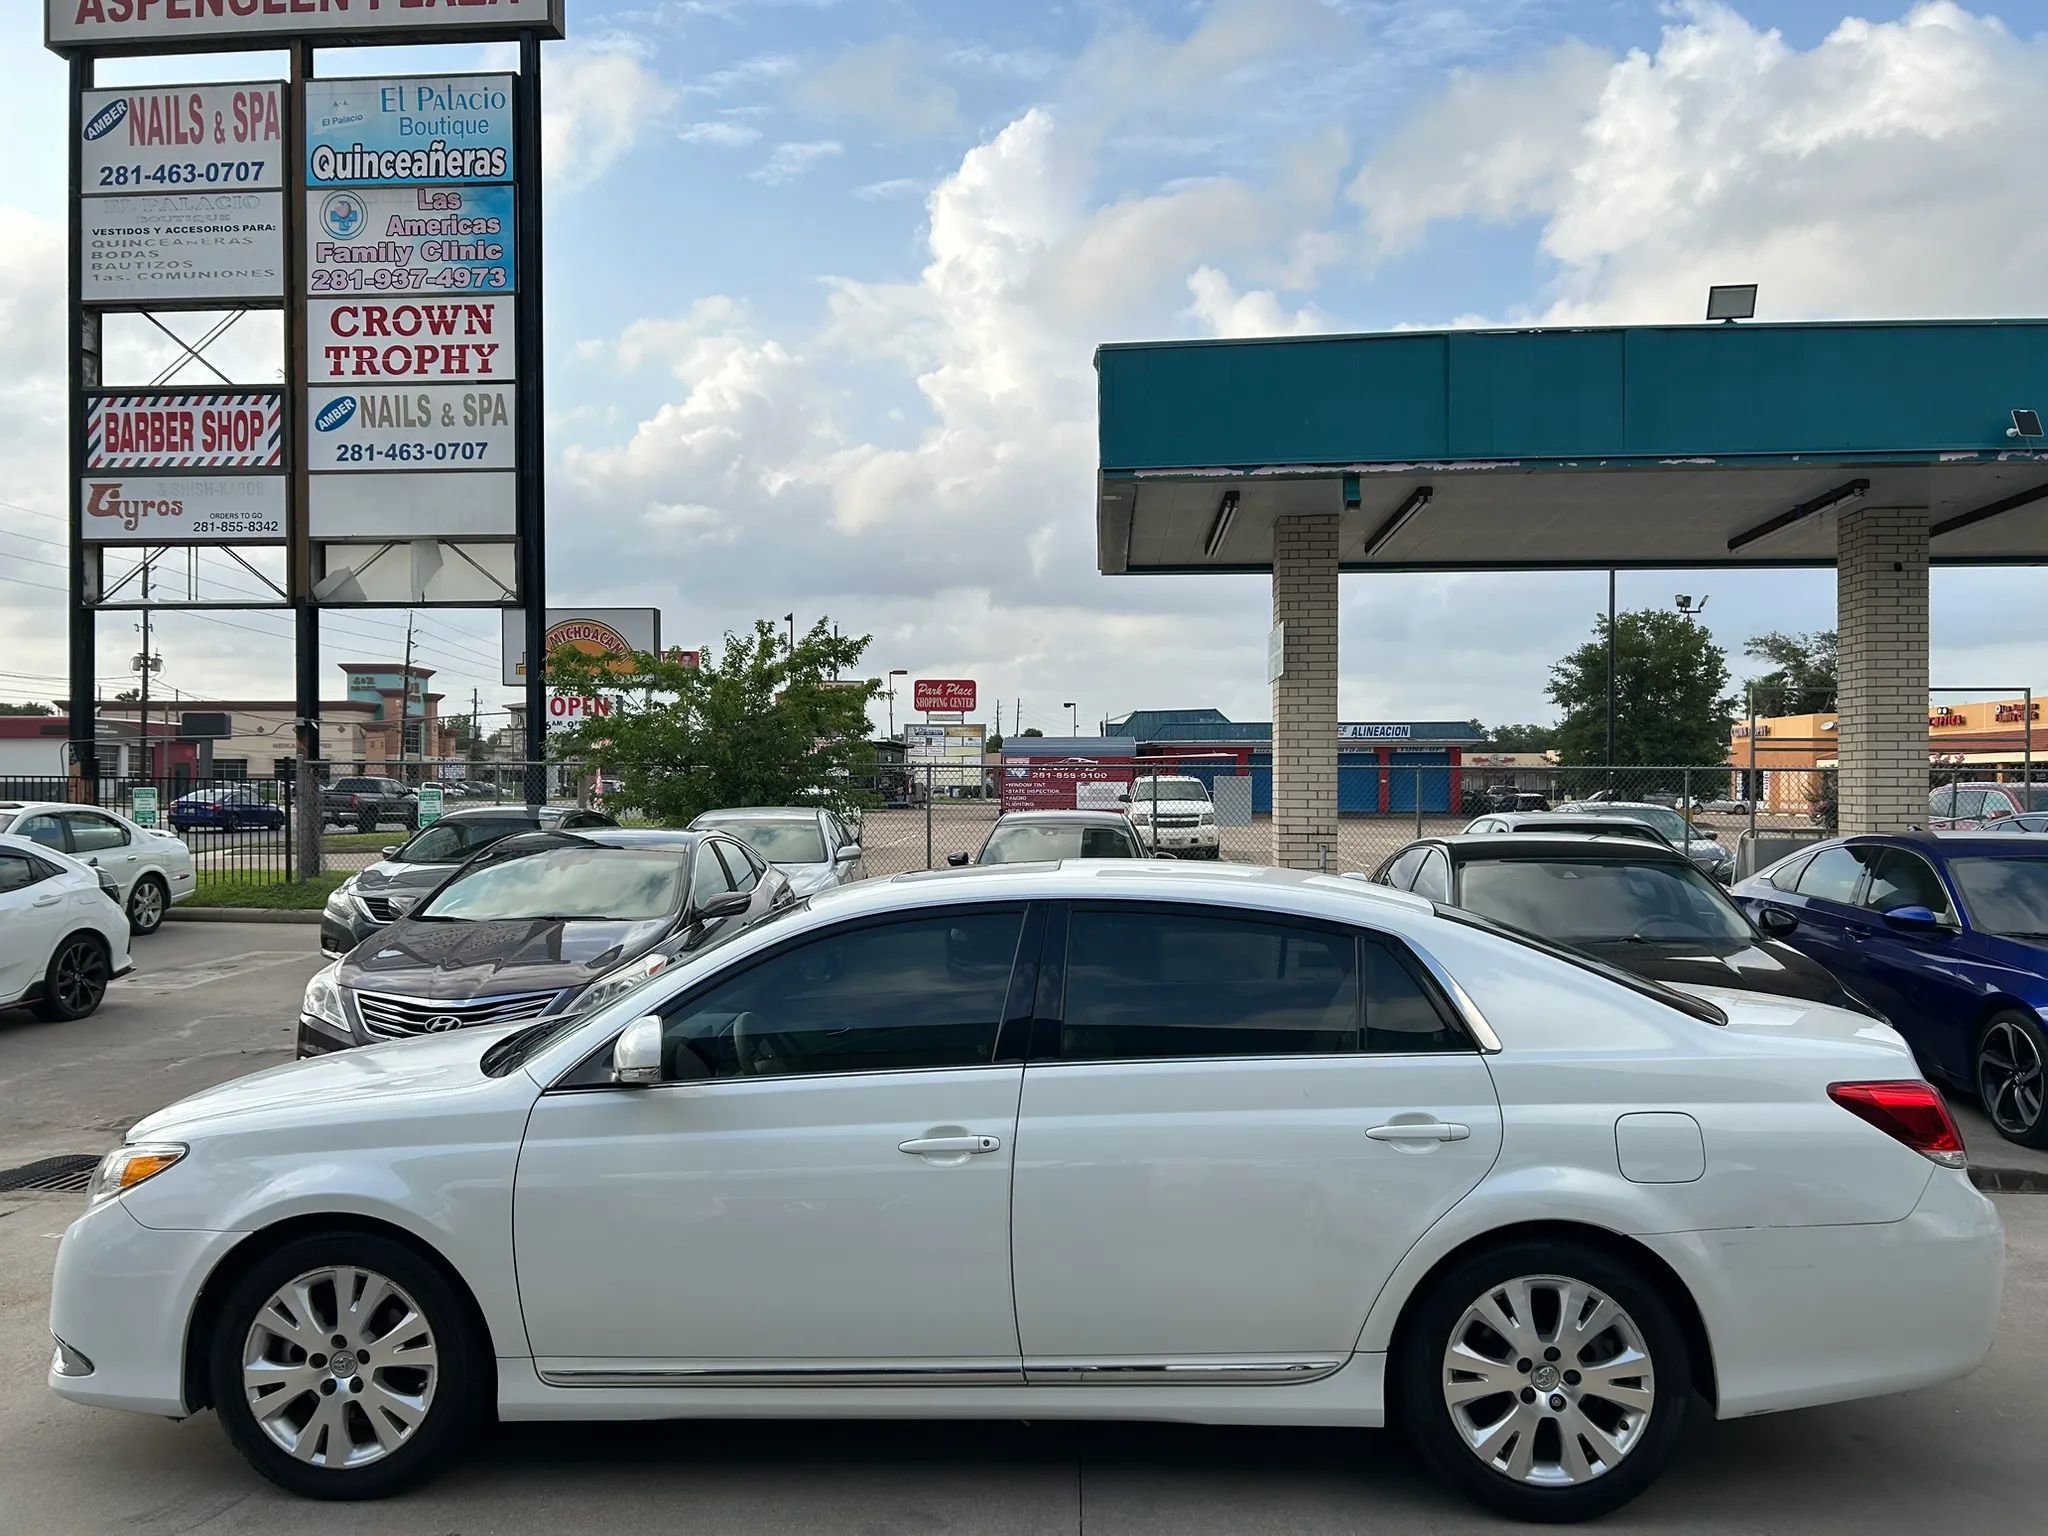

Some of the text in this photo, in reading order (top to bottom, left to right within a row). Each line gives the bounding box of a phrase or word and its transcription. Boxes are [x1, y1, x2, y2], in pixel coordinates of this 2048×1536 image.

[381, 85, 405, 113] El
[87, 100, 128, 140] AMBER
[128, 90, 281, 146] NAILS & SPA
[322, 113, 364, 127] El Palacio
[400, 116, 489, 139] Boutique
[311, 140, 507, 180] Quinceañeras
[99, 161, 265, 186] 281-463-0707
[142, 195, 261, 213] PALACIO
[417, 188, 463, 210] Las
[92, 223, 276, 236] VESTIDOS Y ACCESORIOS PARA:
[136, 214, 231, 224] BOUTIQUE
[386, 214, 501, 236] Americas
[91, 250, 160, 260] BODAS
[316, 240, 504, 267] Family Clinic
[91, 260, 194, 271] BAUTIZOS
[136, 269, 275, 281] COMUNIONES
[311, 267, 507, 290] 281-937-4973
[330, 304, 495, 337] CROWN
[324, 343, 499, 376] TROPHY
[318, 398, 356, 431] AMBER
[360, 393, 509, 428] NAILS & SPA
[105, 409, 264, 453] BARBER SHOP
[336, 442, 488, 462] 281-463-0707
[87, 483, 183, 531] Gyros
[209, 512, 239, 520] ORDERS
[193, 521, 278, 532] 281-855-8342
[918, 683, 973, 696] Park Place
[550, 697, 609, 717] OPEN
[915, 697, 974, 708] SHOPPING CENTER
[1351, 726, 1409, 737] ALINEACION
